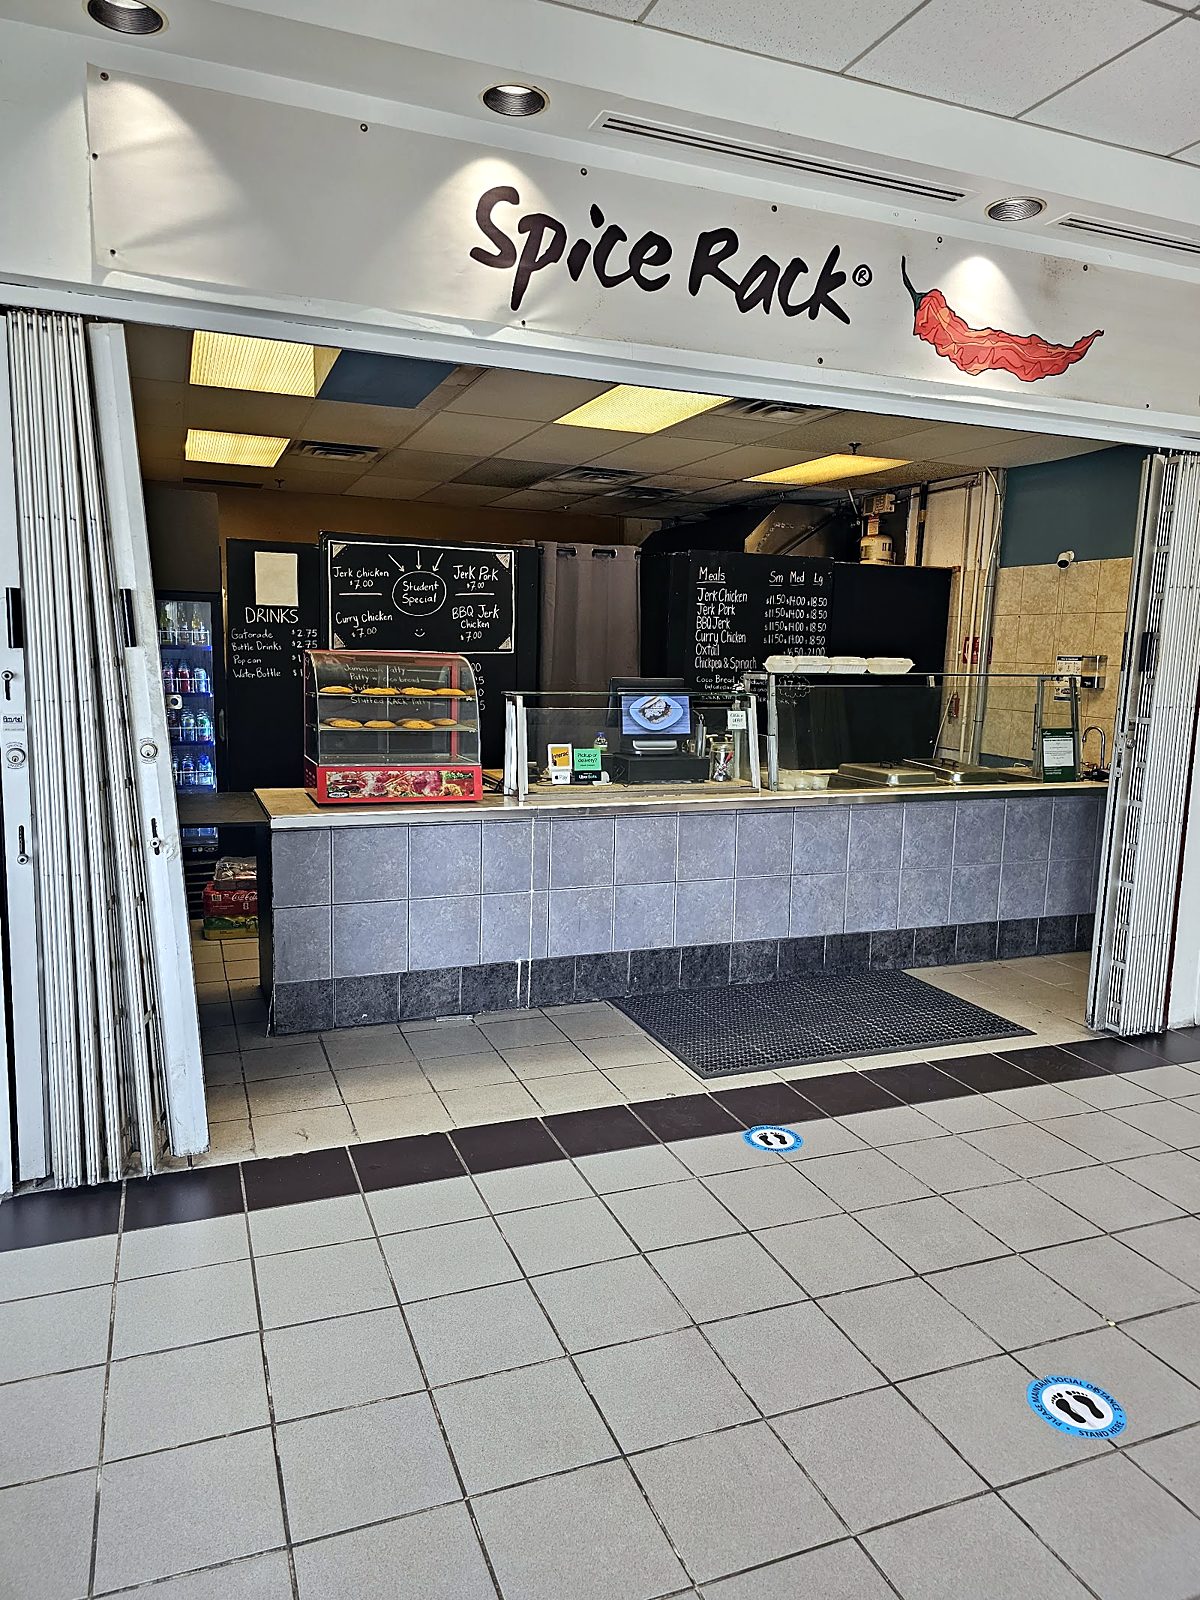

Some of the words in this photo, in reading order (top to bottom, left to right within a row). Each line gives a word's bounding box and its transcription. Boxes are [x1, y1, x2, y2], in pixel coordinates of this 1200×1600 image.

[469, 185, 673, 312] Spice
[332, 566, 353, 578] Jerk
[698, 566, 726, 581] Meals
[768, 570, 784, 583] Sm
[789, 571, 805, 583] Med
[813, 572, 824, 586] Lg
[402, 580, 440, 592] Student
[402, 592, 437, 607] Special
[696, 587, 718, 602] Jerk
[718, 588, 748, 603] Chicken
[245, 606, 299, 624] DRINKS
[451, 605, 474, 620] BBQ
[478, 603, 500, 619] Jerk
[696, 602, 716, 616] Jerk
[718, 602, 736, 616] Pork
[335, 611, 360, 628] Curry
[460, 618, 490, 629] Chicken
[712, 616, 731, 630] Jerk
[231, 628, 274, 640] Gatorade
[291, 628, 318, 638] $2.75
[694, 629, 719, 647] Curry
[720, 629, 747, 644] Chicken
[231, 642, 254, 652] Bottle
[256, 640, 282, 651] Drinks
[291, 639, 318, 649] $2.75
[695, 642, 720, 656] Oxtail
[388, 665, 406, 676] atty
[723, 656, 730, 669] &
[729, 656, 757, 672] Spinach
[232, 668, 256, 679] Water
[349, 672, 369, 683] Patty
[696, 675, 714, 683] Coco
[715, 674, 735, 684] Bread
[1051, 1376, 1085, 1387] SOCIAL
[1031, 1376, 1052, 1403] MAINTAIN
[1086, 1383, 1123, 1413] DISTANCE
[1034, 1403, 1063, 1427] PLEASE
[1078, 1429, 1110, 1438] STAND
[1109, 1420, 1125, 1435] HERE
